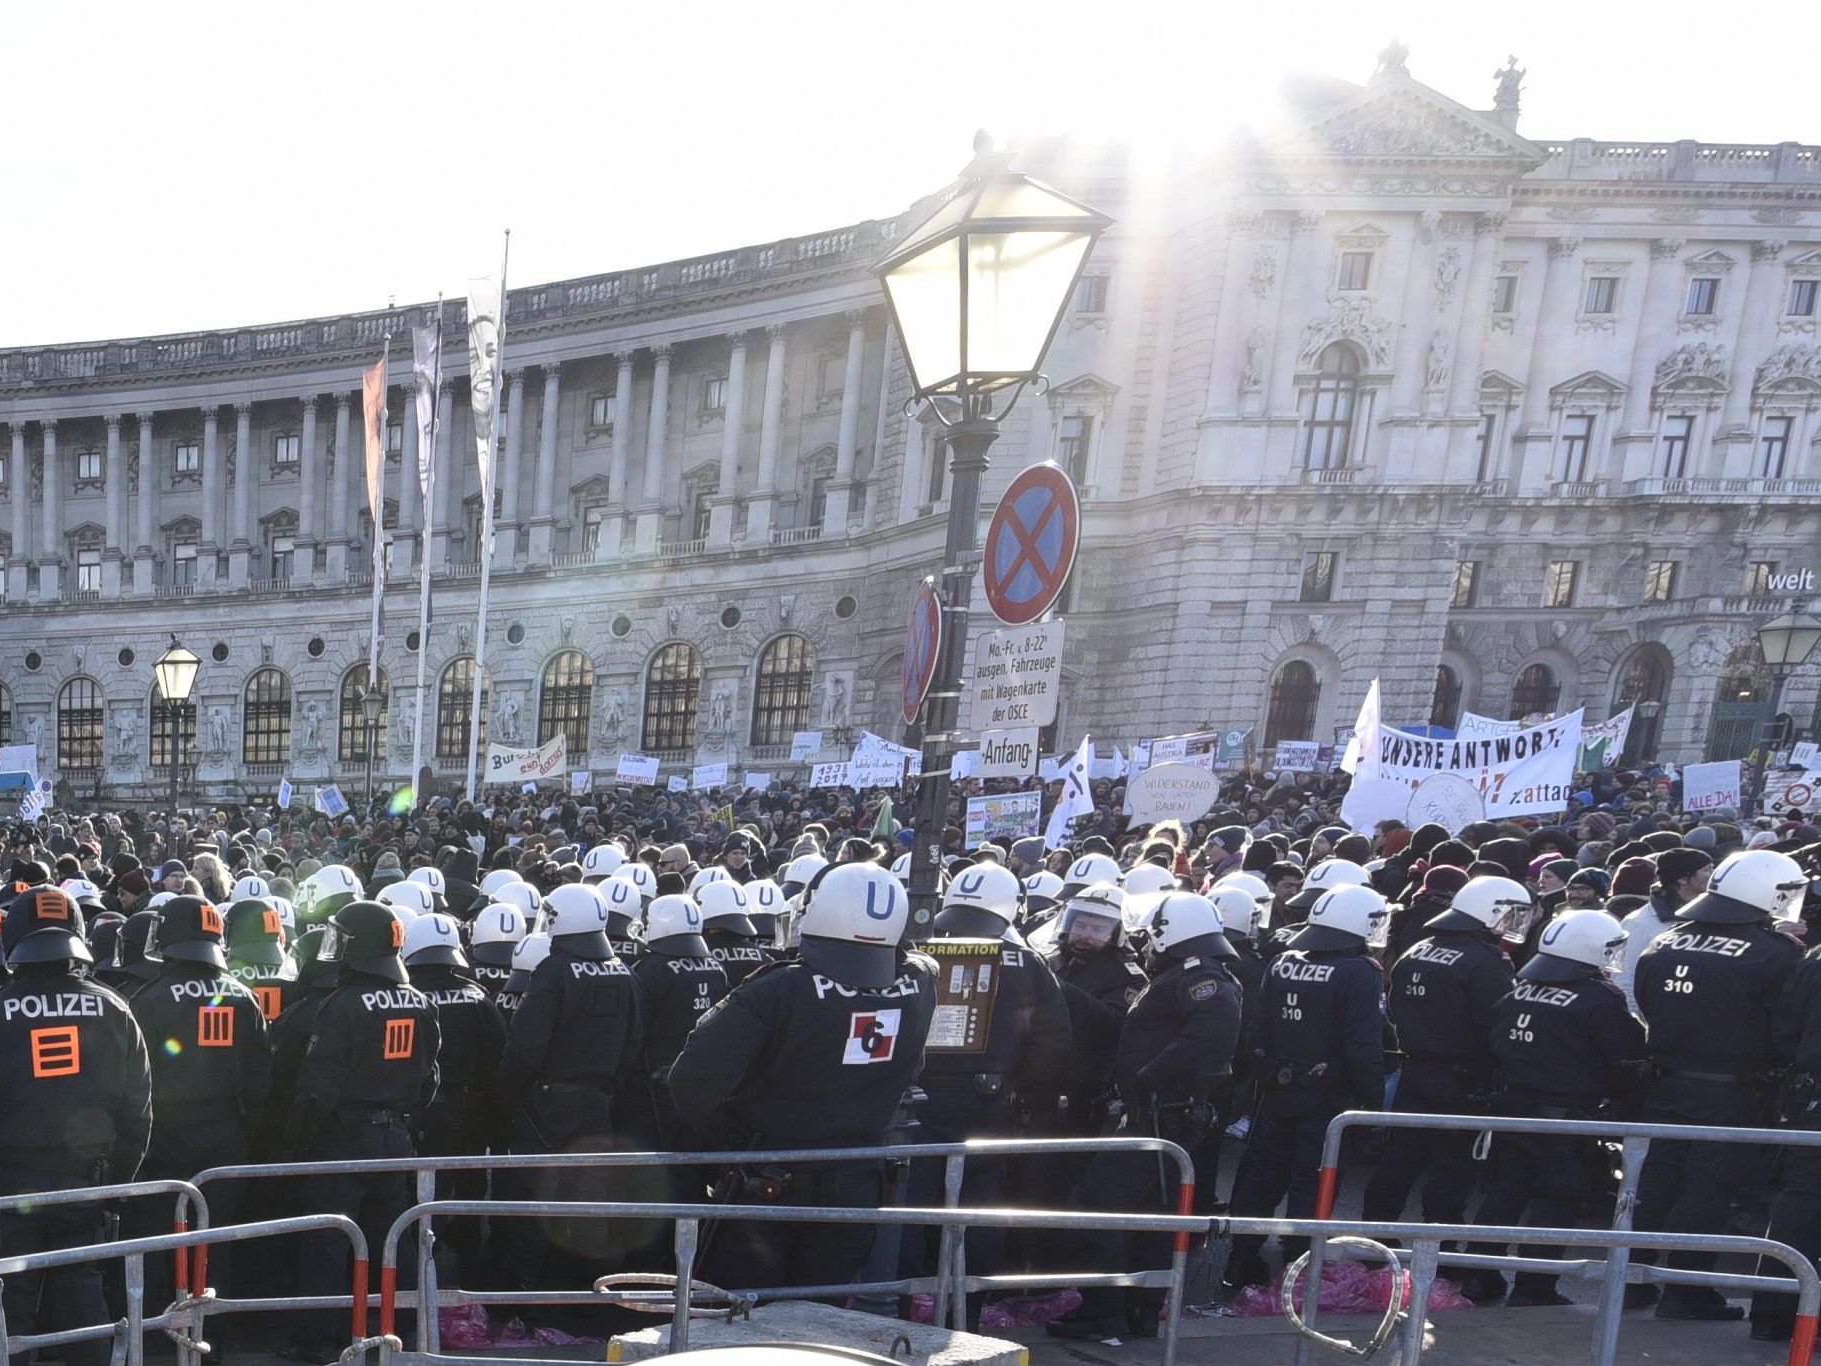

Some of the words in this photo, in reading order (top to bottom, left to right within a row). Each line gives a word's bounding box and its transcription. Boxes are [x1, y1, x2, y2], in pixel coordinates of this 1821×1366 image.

[1767, 567, 1815, 591] welt
[988, 640, 1015, 659] Mo.-Fr.
[977, 663, 1008, 679] ausgen.
[1011, 655, 1056, 674] Fahrzeuge
[980, 684, 994, 701] mit
[996, 679, 1047, 702] Wagenkarte
[992, 706, 1006, 722] der
[1007, 703, 1029, 721] OSCE
[984, 737, 1030, 769] Anfang
[1152, 750, 1183, 759] AUSTRIA
[1381, 736, 1444, 769] UNSERE
[818, 763, 849, 776] 1938
[1144, 779, 1211, 791] WIDERSTAND
[1524, 783, 1571, 804] attac
[1688, 794, 1713, 809] ALLE
[587, 852, 598, 869] U
[1073, 860, 1093, 878] U
[340, 869, 354, 887] U
[428, 871, 439, 887] U
[633, 868, 647, 886] U
[1311, 863, 1334, 882] U
[1711, 859, 1741, 884] U
[249, 880, 260, 896] U
[959, 873, 985, 894] U
[1027, 876, 1043, 890] U
[420, 889, 431, 909] U
[528, 890, 540, 910] U
[611, 883, 629, 904] U
[732, 886, 748, 907] U
[759, 886, 774, 906] U
[866, 881, 895, 920] U
[595, 897, 609, 922] U
[684, 903, 700, 926] U
[1312, 893, 1335, 917] U
[433, 917, 451, 935] U
[500, 912, 515, 934] U
[1542, 922, 1567, 946] U
[1664, 932, 1753, 958] POLIZEI
[710, 947, 763, 963] OLIZEI
[570, 961, 631, 979] POLIZEI
[667, 956, 724, 975] POLIZEI
[1271, 962, 1336, 984] POLIZEI
[1675, 964, 1690, 978] U
[1412, 972, 1422, 983] U
[1663, 979, 1694, 994] 310
[169, 979, 253, 1003] POLIZEI
[698, 982, 708, 996] U
[1405, 984, 1426, 997] 310
[3, 992, 105, 1021] POLIZEI
[361, 989, 430, 1012] POLIZEI
[693, 997, 711, 1011] 320
[1287, 992, 1298, 1007] U
[1281, 1007, 1302, 1021] 310
[1516, 1013, 1532, 1029] U
[860, 1019, 884, 1055] 6
[1509, 1028, 1534, 1043] 310
